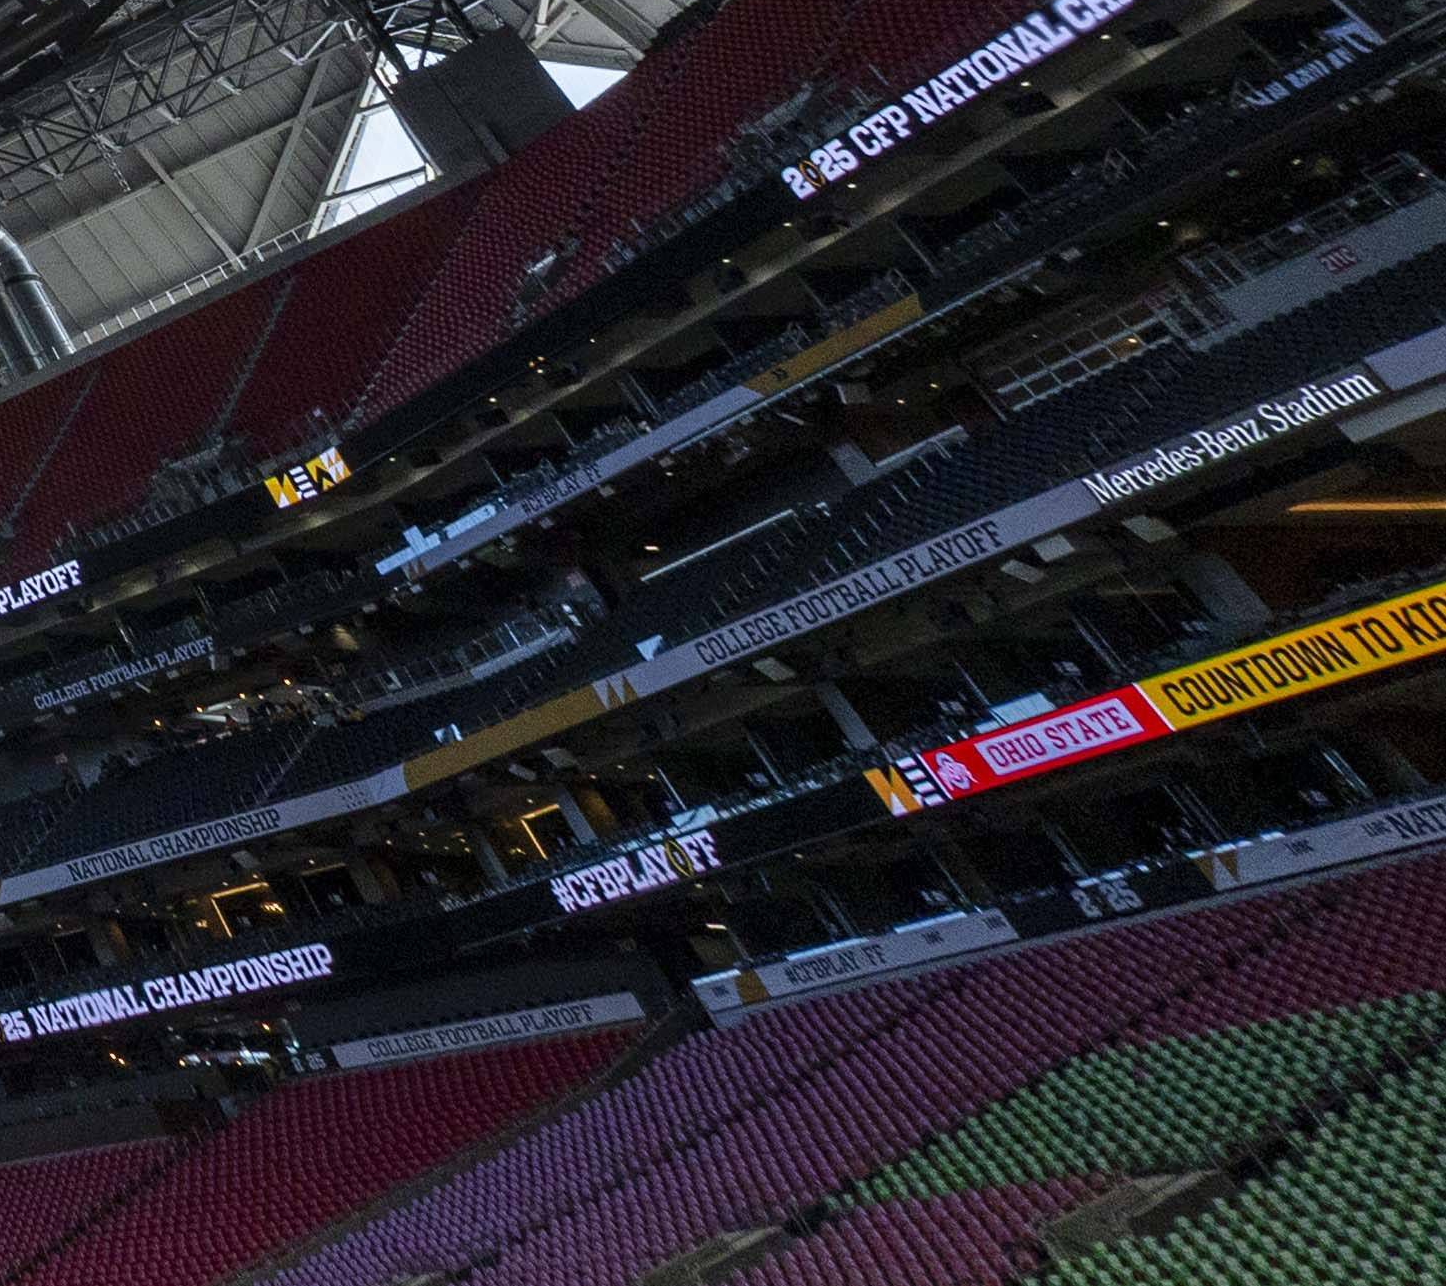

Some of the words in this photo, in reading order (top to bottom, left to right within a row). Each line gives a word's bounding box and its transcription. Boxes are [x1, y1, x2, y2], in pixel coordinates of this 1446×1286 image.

[781, 138, 860, 202] 2025
[848, 104, 911, 157] CFP
[901, 11, 1077, 124] NATIONAL
[1083, 419, 1269, 504] Mercedes-Benz
[1257, 374, 1381, 433] Stadium
[696, 611, 789, 665] COLLEGE
[783, 568, 902, 630] FOOTBALL
[896, 520, 1004, 583] PLAYOFF
[33, 679, 92, 709] COLLEGE
[89, 658, 157, 692] FOOTBALL
[155, 636, 214, 669] PLAYOFF
[1162, 631, 1358, 716] COUNTDOWN
[1341, 617, 1403, 659] TO
[1389, 593, 1446, 646] KIC
[987, 733, 1046, 767] OHIO
[1045, 706, 1131, 749] STATE
[67, 844, 152, 881] NATIONAL
[150, 808, 281, 863] CHAMPIONSHIP
[1386, 804, 1446, 840] NAT
[1071, 878, 1145, 918] 225
[27, 984, 150, 1035] NATIONAL
[143, 942, 334, 1009] CHAMPIONSHIP
[783, 943, 885, 985] #CFBPLAYFF
[367, 1031, 433, 1059] COLLEGE
[438, 1018, 520, 1048] FOOTBALL
[520, 1004, 595, 1033] PLAYOFF
